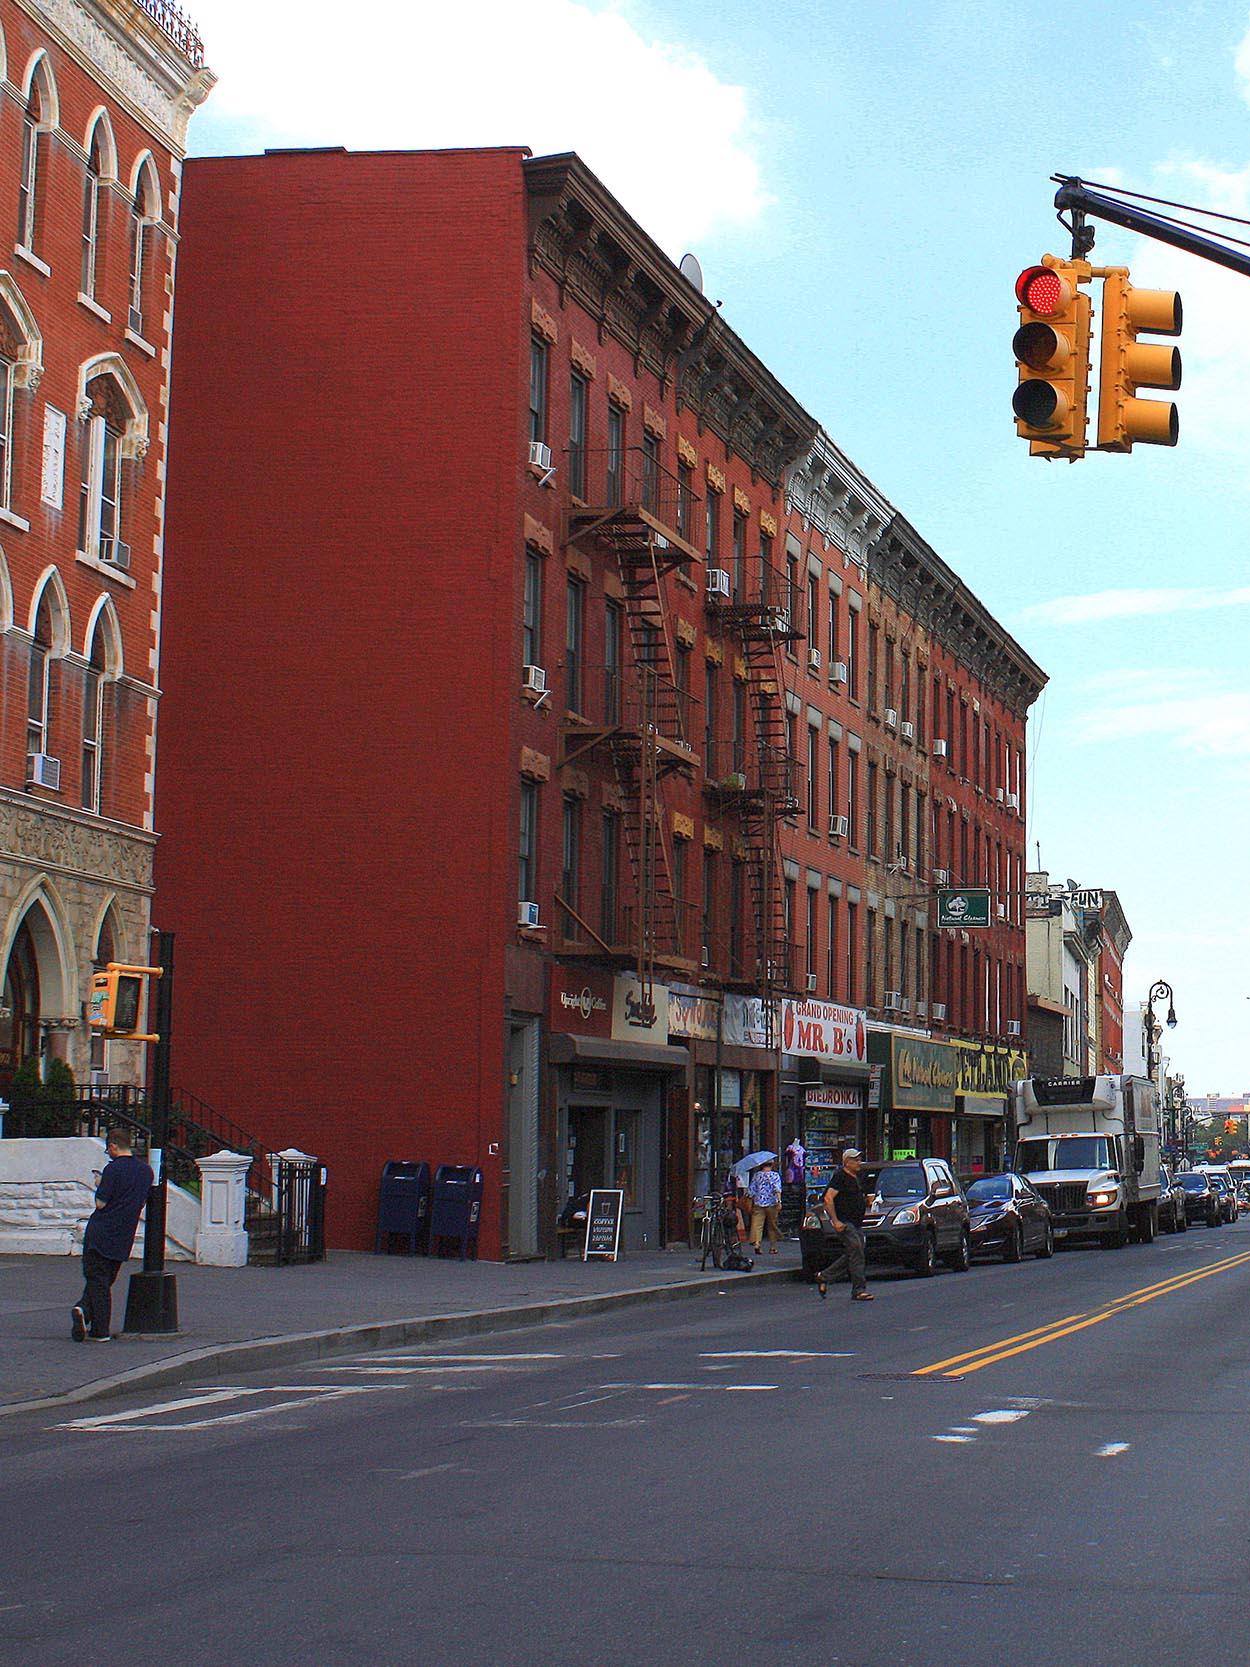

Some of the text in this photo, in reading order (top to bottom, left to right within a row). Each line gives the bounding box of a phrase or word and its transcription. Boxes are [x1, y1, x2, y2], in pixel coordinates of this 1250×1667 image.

[795, 1001, 854, 1025] GRAND OPENING
[797, 1020, 829, 1054] MR.
[833, 1026, 853, 1055] B's
[807, 1089, 858, 1105] BIEDRONKA
